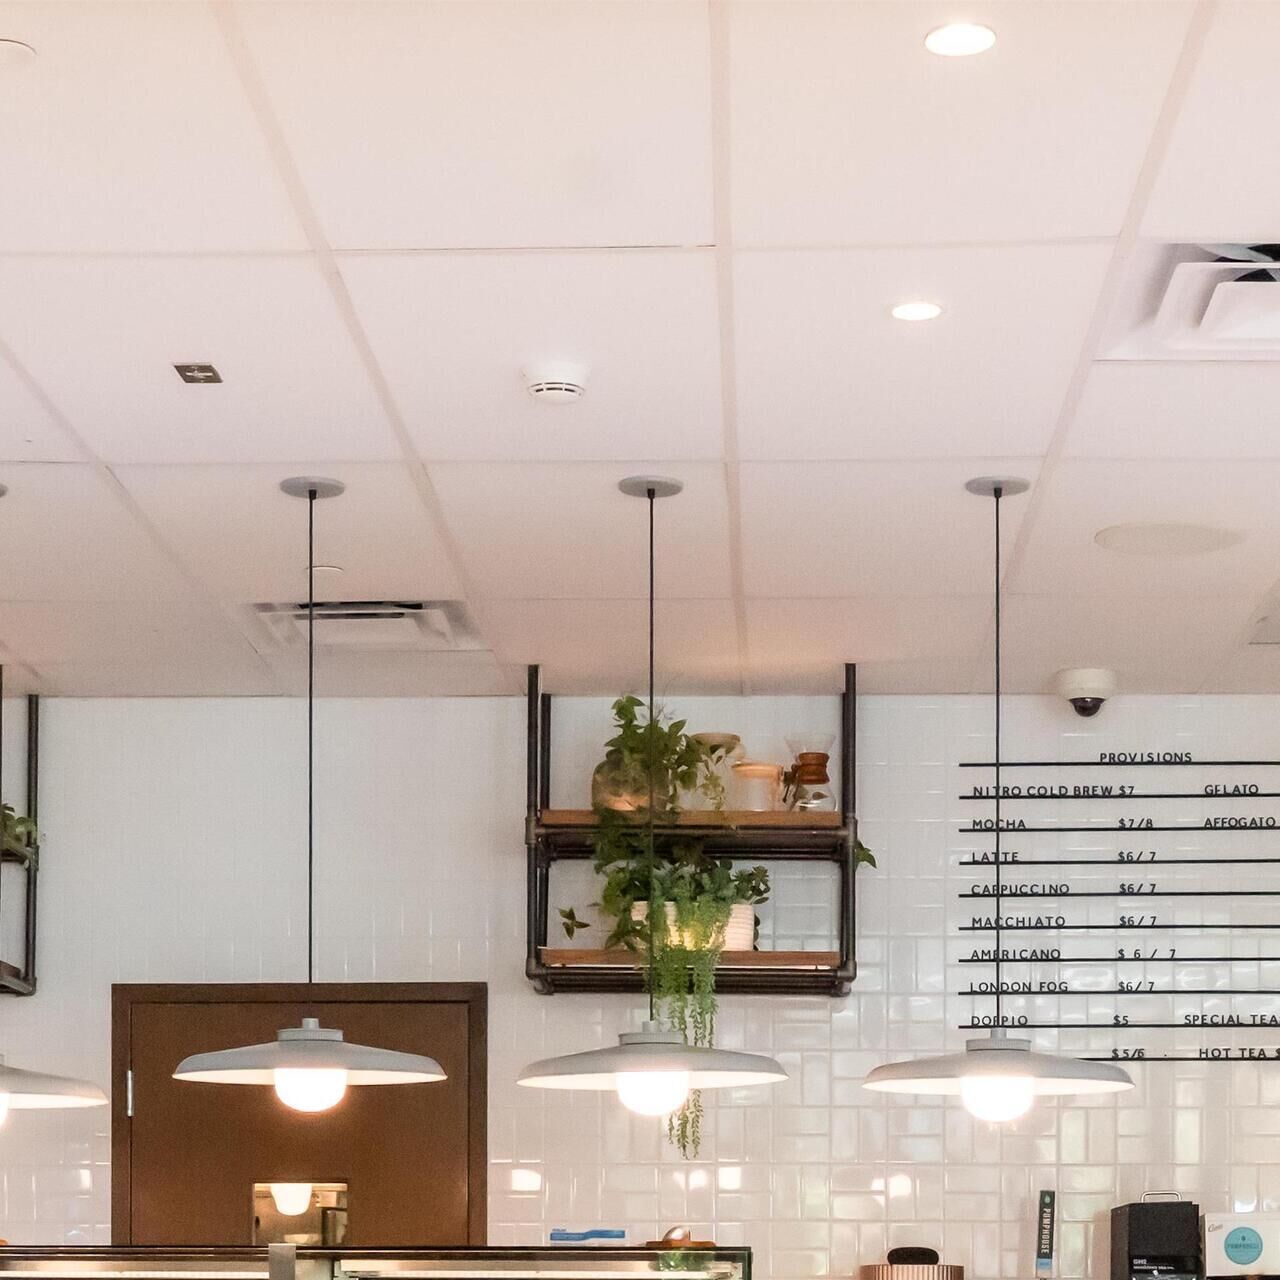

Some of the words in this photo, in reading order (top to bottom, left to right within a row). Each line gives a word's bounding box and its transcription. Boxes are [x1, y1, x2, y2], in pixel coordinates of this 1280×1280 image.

[1098, 752, 1193, 764] PROVISIONS
[973, 786, 1022, 797] NITRO
[1026, 785, 1068, 797] COLD
[1073, 785, 1113, 796] BREW
[1119, 784, 1135, 796] $7
[1204, 784, 1259, 795] GELATO
[972, 819, 1026, 830] MOCHA
[1118, 817, 1154, 829] $7/8
[1204, 817, 1276, 828] AFFOGATO
[972, 852, 1019, 863] LATTE
[971, 883, 1070, 895] CAPPUCCINO
[972, 916, 1065, 928] MACCHIATO
[971, 949, 1061, 960] AMERICANO
[970, 982, 1031, 993] LONDON
[1039, 982, 1069, 993] FOG
[971, 1015, 1029, 1026] DOPPIO
[1113, 1014, 1129, 1026] $5
[1184, 1014, 1244, 1025] SPECIAL
[1199, 1048, 1231, 1059] HOT
[1239, 1048, 1267, 1059] TEA
[1040, 1208, 1052, 1254] PUMPHOUSE
